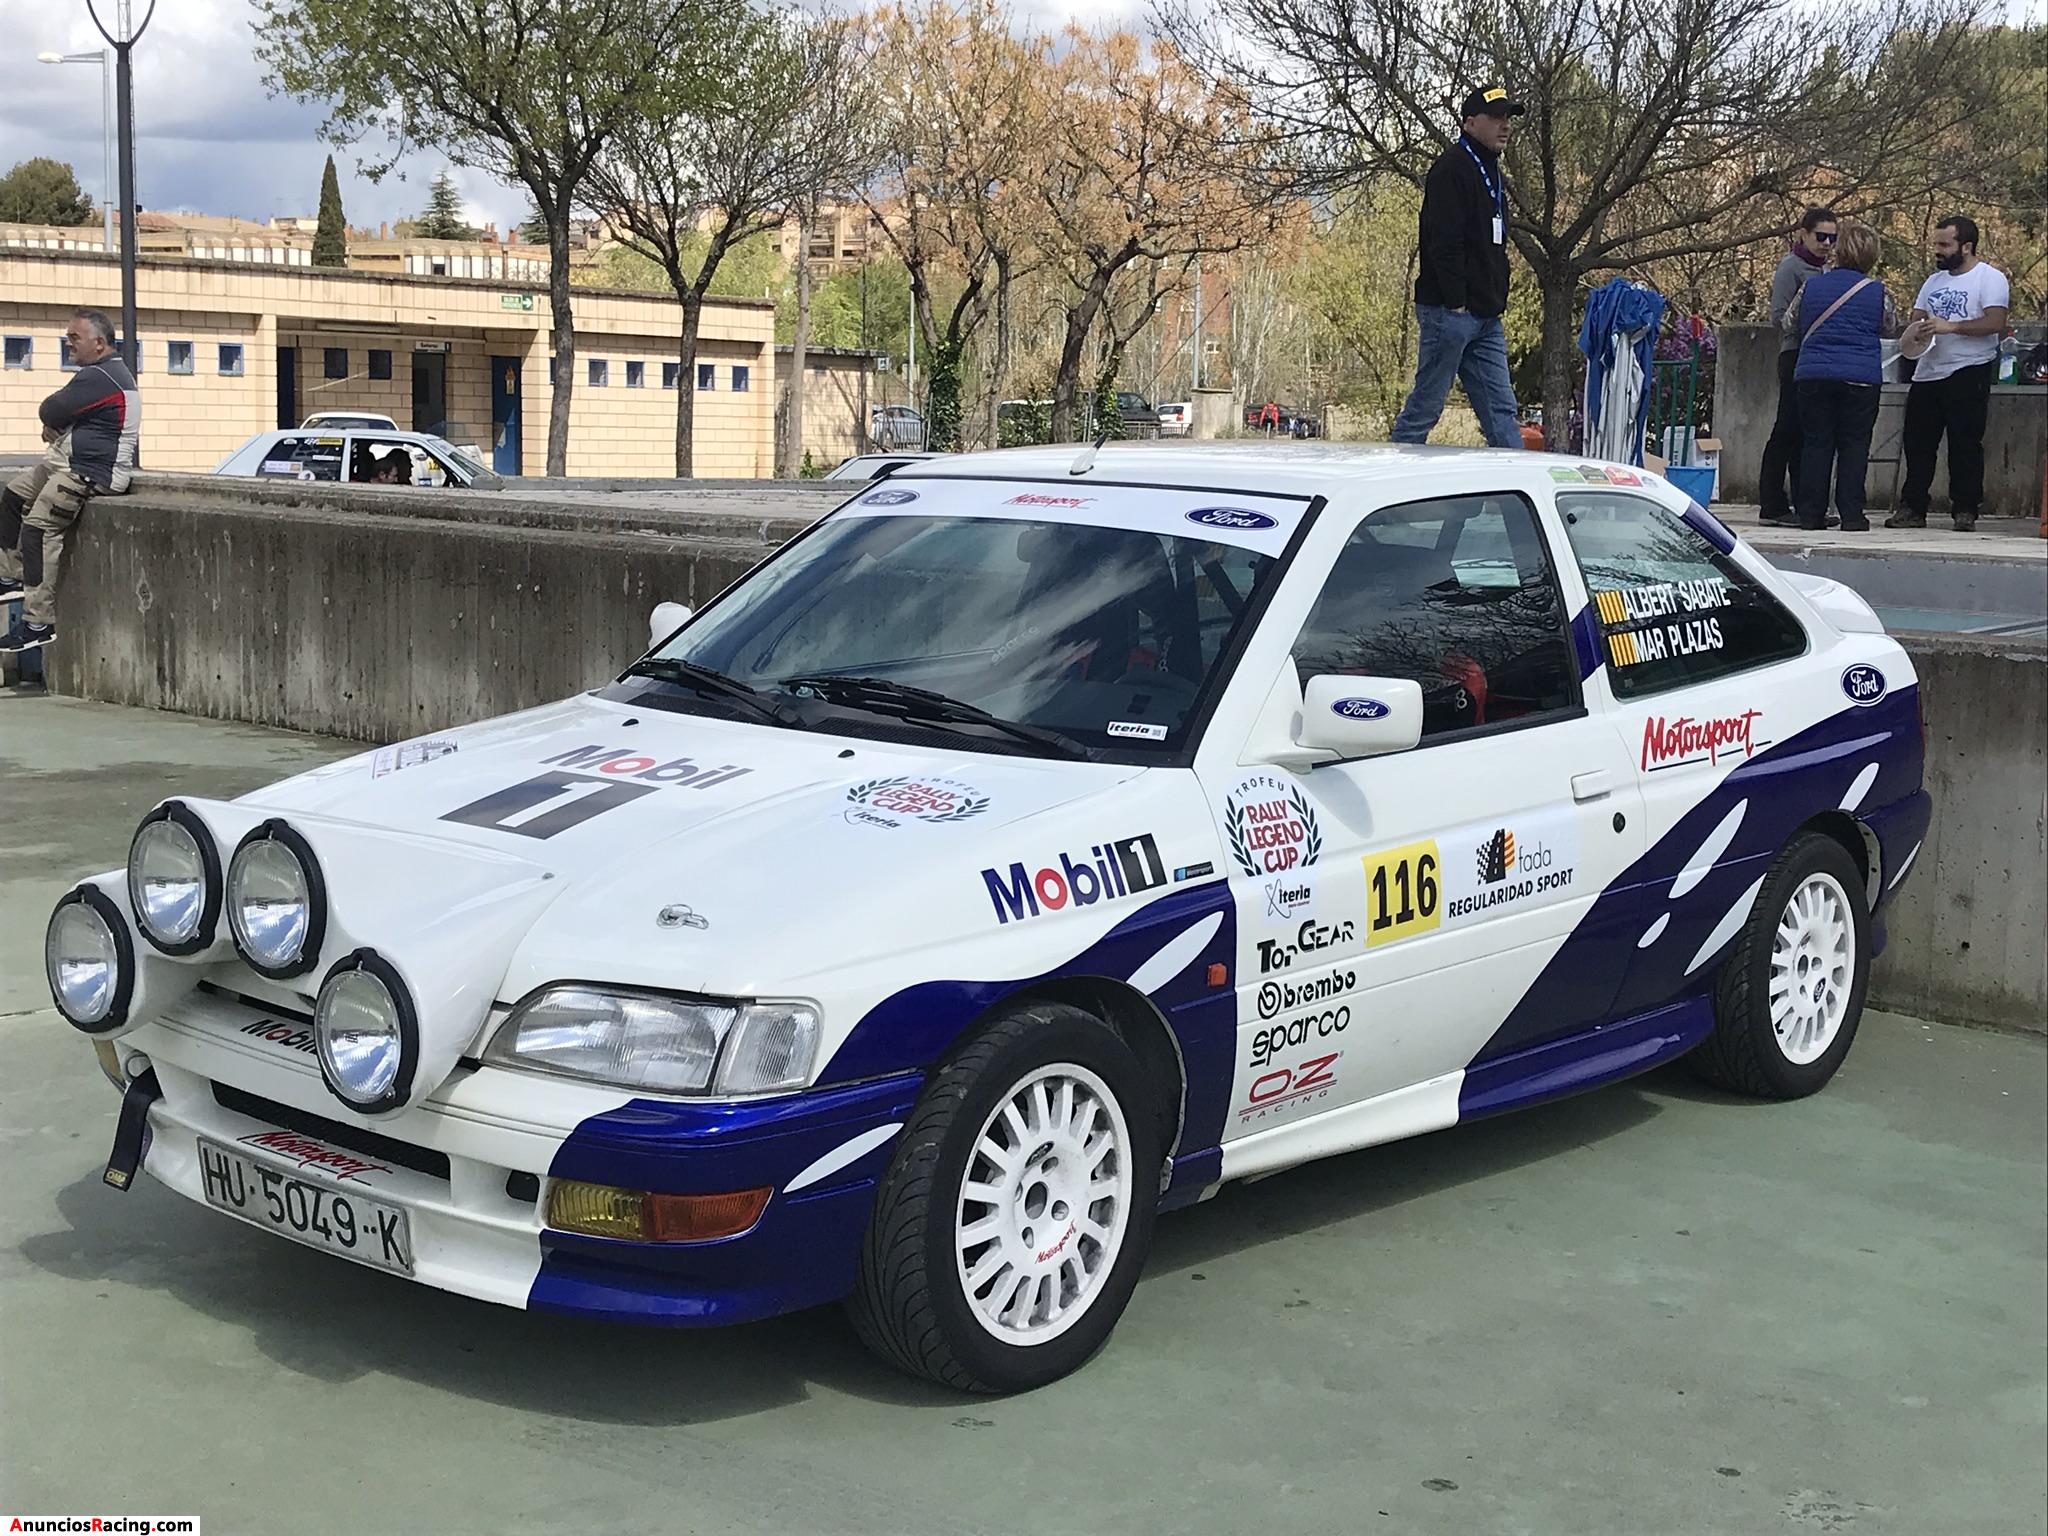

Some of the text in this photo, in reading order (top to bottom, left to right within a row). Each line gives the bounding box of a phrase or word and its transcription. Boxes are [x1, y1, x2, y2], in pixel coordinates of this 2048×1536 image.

[1199, 508, 1263, 528] Ford
[1622, 577, 1731, 620] ALBERT SABATE
[1632, 617, 1724, 663] MAR PLAZAS
[1341, 699, 1380, 718] Ford
[1641, 708, 1763, 773] Motorsport
[538, 745, 755, 789] Mobil
[874, 788, 955, 812] LEGEND
[902, 783, 964, 801] RALLY
[1235, 776, 1284, 798] TROFEU
[872, 798, 924, 814] CUP
[1246, 800, 1288, 825] RALLY
[1246, 820, 1304, 851] LEGEND
[1264, 847, 1299, 874] CUP
[1518, 841, 1552, 874] fada
[1372, 853, 1437, 931] 116
[1449, 868, 1574, 918] REGULARIDAD SPORT
[1284, 969, 1356, 1009] brembo
[1251, 1005, 1351, 1067] sparco
[1241, 1089, 1329, 1125] RACING
[237, 1131, 393, 1180] Motorsport
